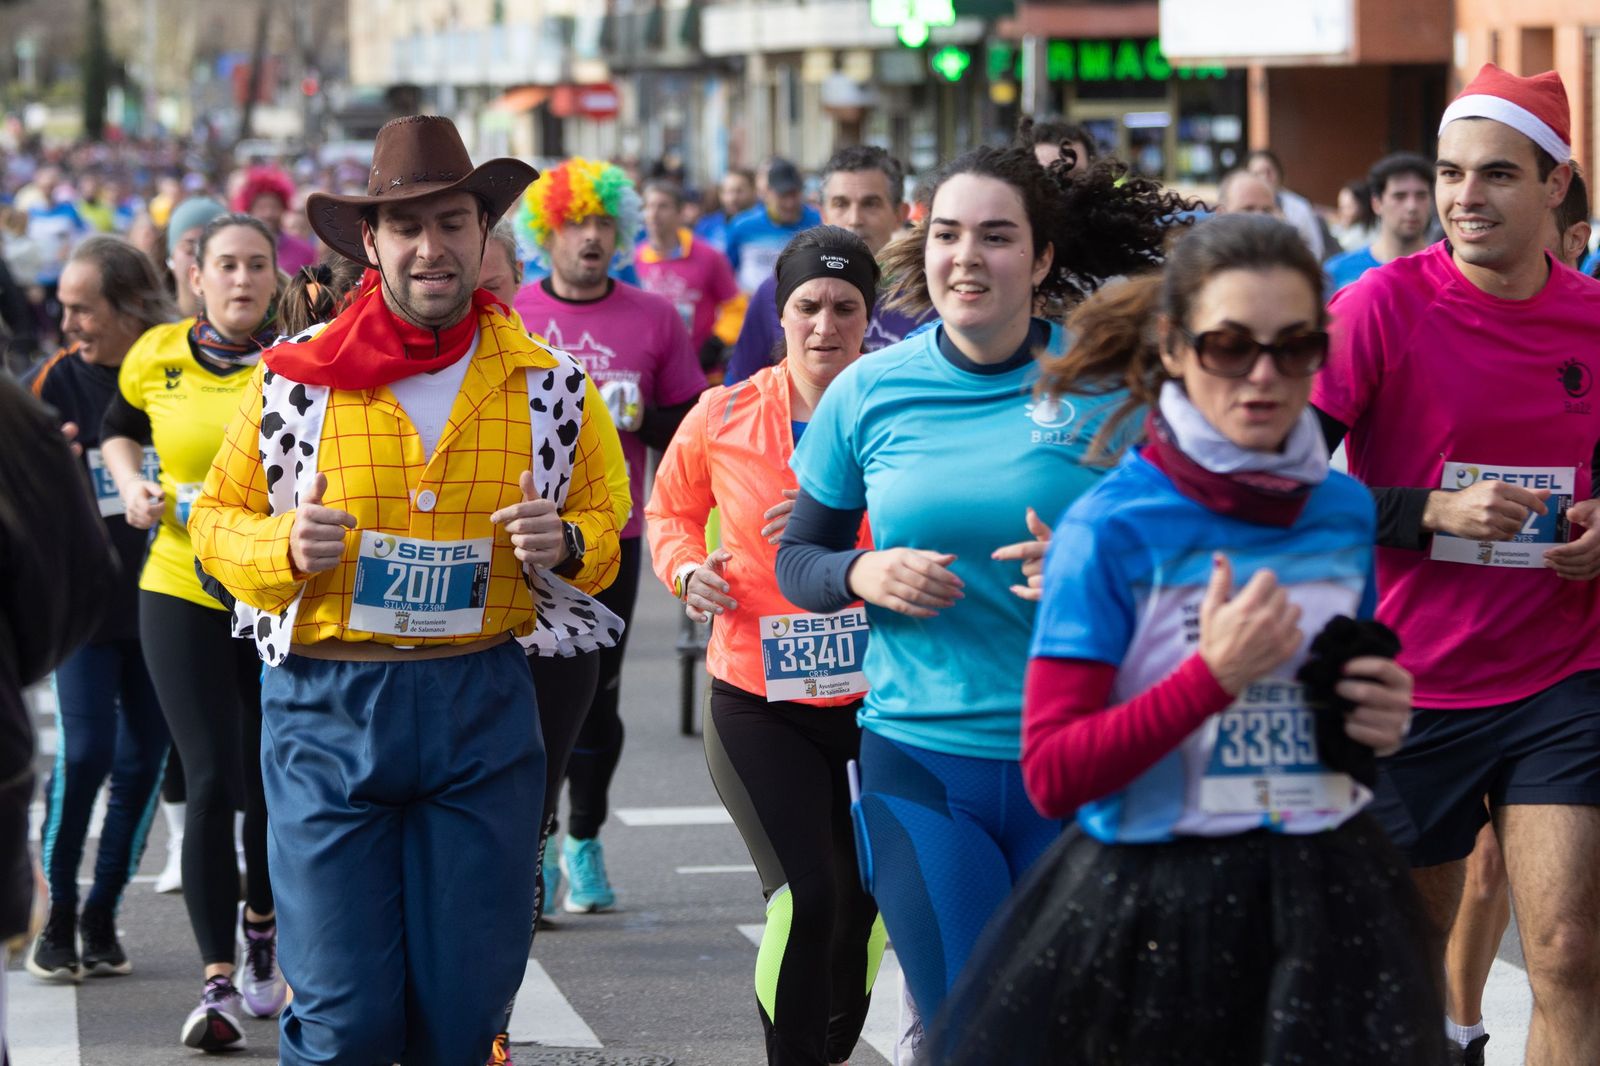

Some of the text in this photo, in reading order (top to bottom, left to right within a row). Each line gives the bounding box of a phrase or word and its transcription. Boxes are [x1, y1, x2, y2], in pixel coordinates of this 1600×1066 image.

[986, 39, 1227, 81] FRMAC
[820, 255, 849, 264] Kalenji
[1512, 534, 1534, 544] EYES
[398, 542, 480, 562] SETEL
[383, 562, 452, 604] 2011
[384, 600, 413, 611] SILVA
[411, 618, 447, 626] Ayuntamiento
[793, 613, 868, 634] SETEL
[778, 632, 855, 672] 3340
[808, 669, 829, 678] CRIS
[819, 681, 850, 690] Ayuntamiento
[826, 687, 850, 697] Salamanca
[1246, 685, 1304, 702] SET
[1221, 711, 1318, 767] 3339
